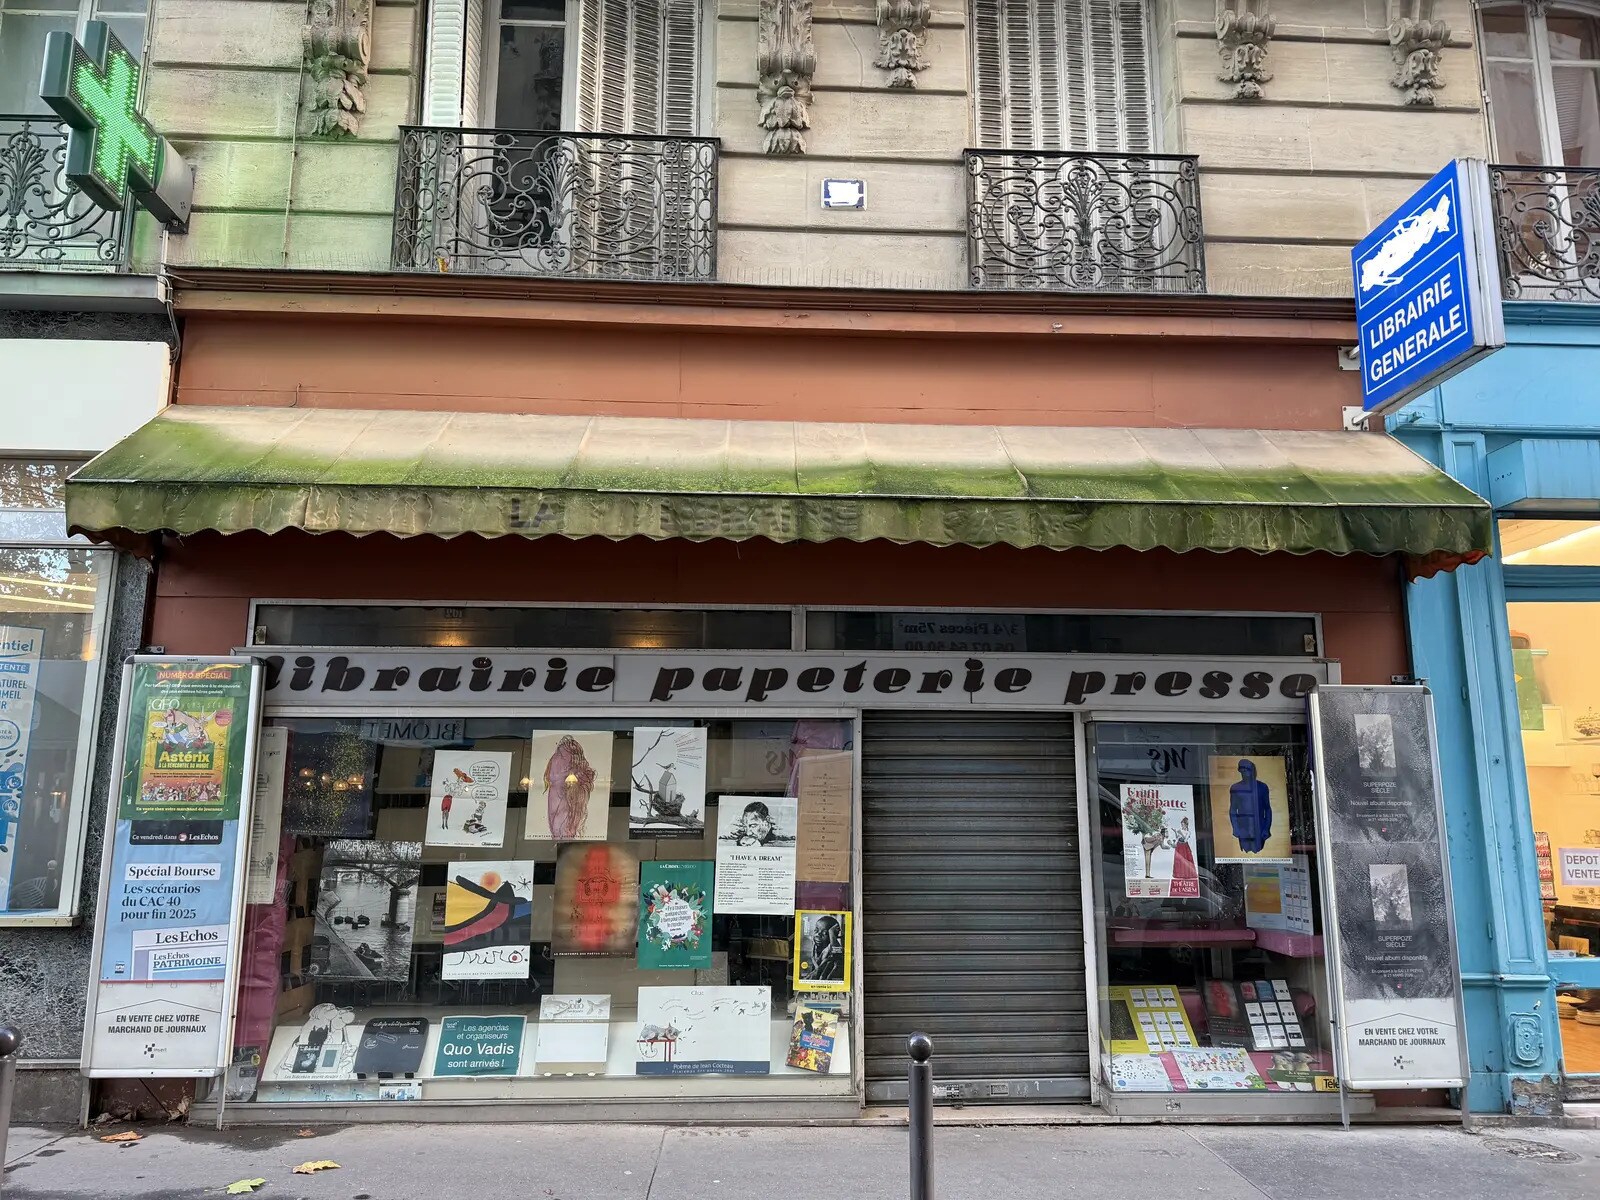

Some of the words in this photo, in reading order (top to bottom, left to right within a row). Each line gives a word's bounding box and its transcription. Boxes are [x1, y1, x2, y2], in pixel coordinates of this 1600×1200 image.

[1370, 273, 1453, 350] LIBRAIRIE
[1370, 304, 1463, 382] GENERALE
[0, 639, 34, 652] ntiel
[265, 655, 616, 693] librairie
[650, 658, 1032, 703] papeterie
[1064, 670, 1317, 705] presse
[159, 751, 210, 763] Astérix
[1155, 799, 1187, 809] patte
[140, 833, 163, 841] vendredi
[330, 840, 349, 850] Willy
[1566, 855, 1599, 864] DEPOT
[128, 866, 171, 879] Spécial
[174, 866, 216, 877] Bourse
[1567, 869, 1600, 879] VENTE
[123, 884, 143, 894] Les
[145, 883, 201, 894] scénarios
[121, 896, 137, 907] du
[139, 896, 166, 907] CAC
[166, 896, 181, 907] 40
[120, 911, 150, 922] pour
[151, 908, 167, 919] fin
[169, 908, 197, 919] 2025
[156, 932, 179, 944] Les
[180, 930, 218, 944] Echos
[153, 957, 221, 969] PATRIMOINE
[154, 1014, 174, 1022] CHEZ
[176, 1014, 200, 1022] VOTRE
[108, 1025, 152, 1034] MARCHAND
[153, 1025, 164, 1033] DE
[165, 1025, 207, 1033] JOURNAUX
[463, 1024, 476, 1032] Les
[478, 1024, 510, 1033] agendas
[456, 1032, 465, 1040] et
[465, 1032, 508, 1041] organiseurs
[1410, 1038, 1446, 1046] JOURNAUX
[443, 1043, 472, 1056] Quo
[477, 1042, 515, 1055] Vadis
[448, 1060, 468, 1068] sont
[469, 1058, 500, 1068] arrivés
